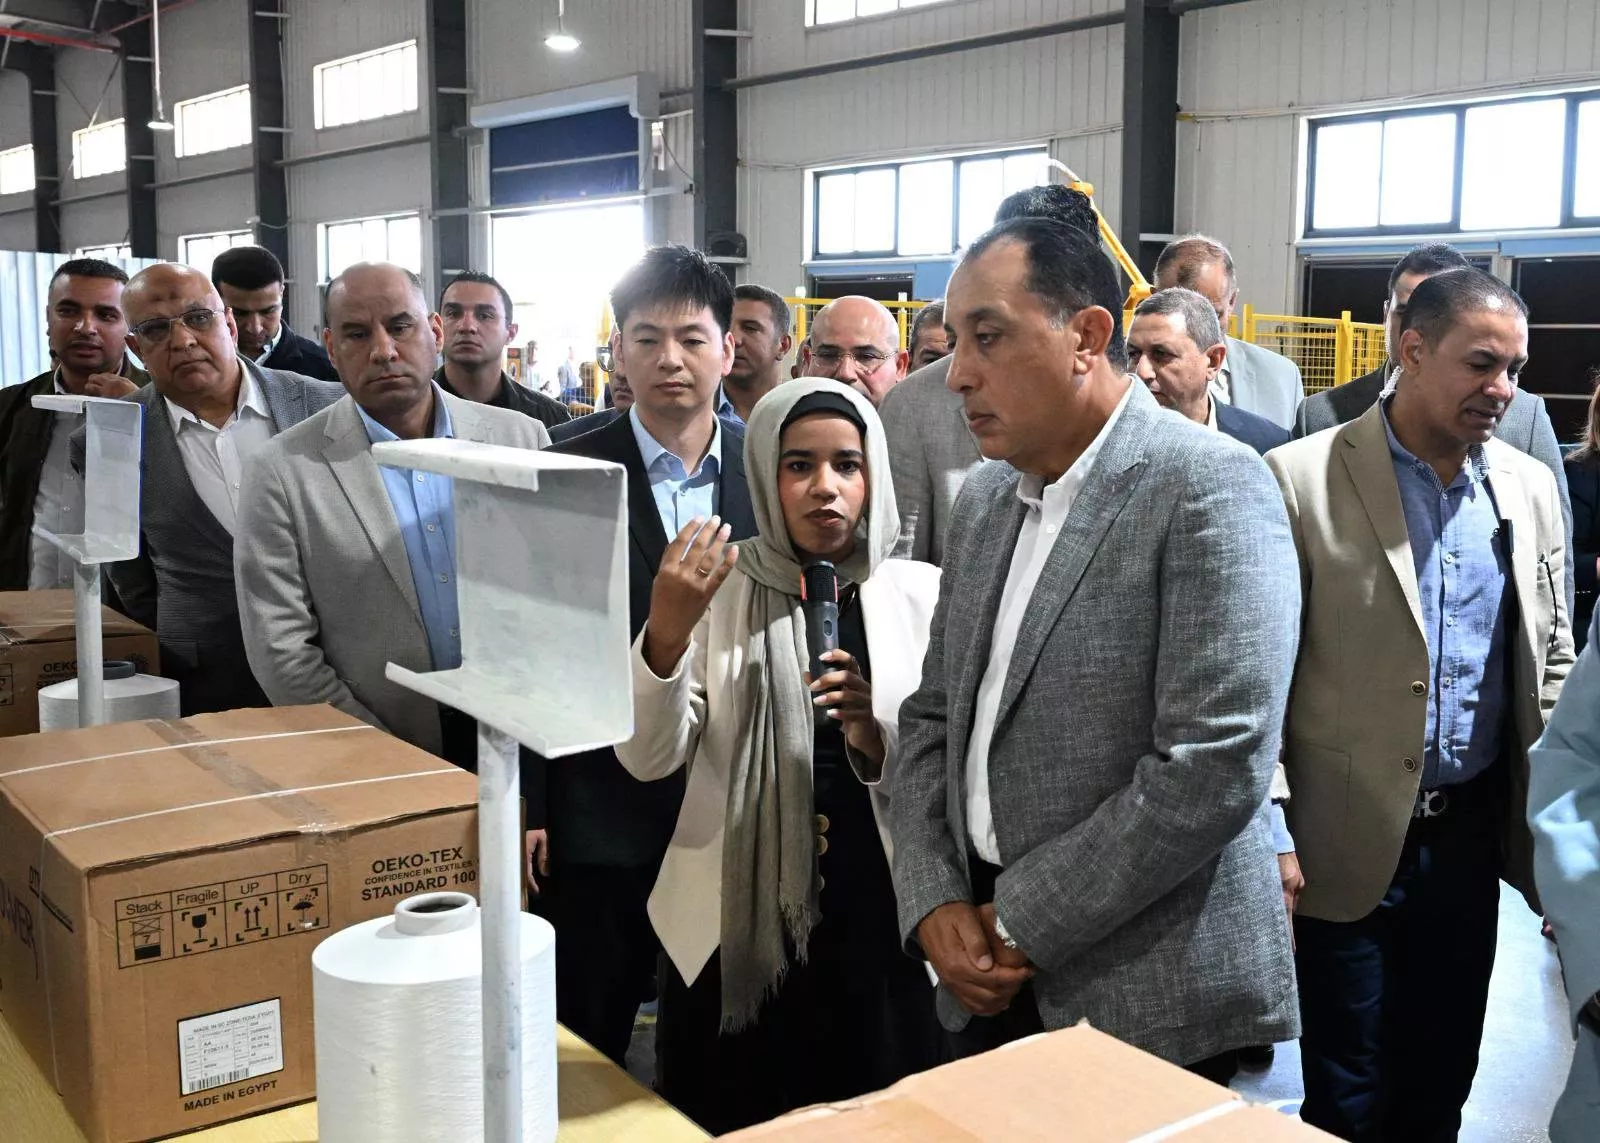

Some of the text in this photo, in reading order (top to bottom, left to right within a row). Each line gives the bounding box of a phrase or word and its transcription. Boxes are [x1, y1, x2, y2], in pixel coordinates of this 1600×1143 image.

[372, 846, 464, 874] OEKO-TEX
[288, 872, 312, 885] Dry
[365, 860, 473, 885] CONFIDENCE IN TEXTILES
[240, 882, 260, 895] UP
[361, 870, 477, 901] STANDARD 100
[177, 889, 219, 905] Fragile
[126, 900, 163, 916] Stack
[143, 934, 151, 944] 7
[184, 1080, 278, 1111] MADE IN EGYPT
